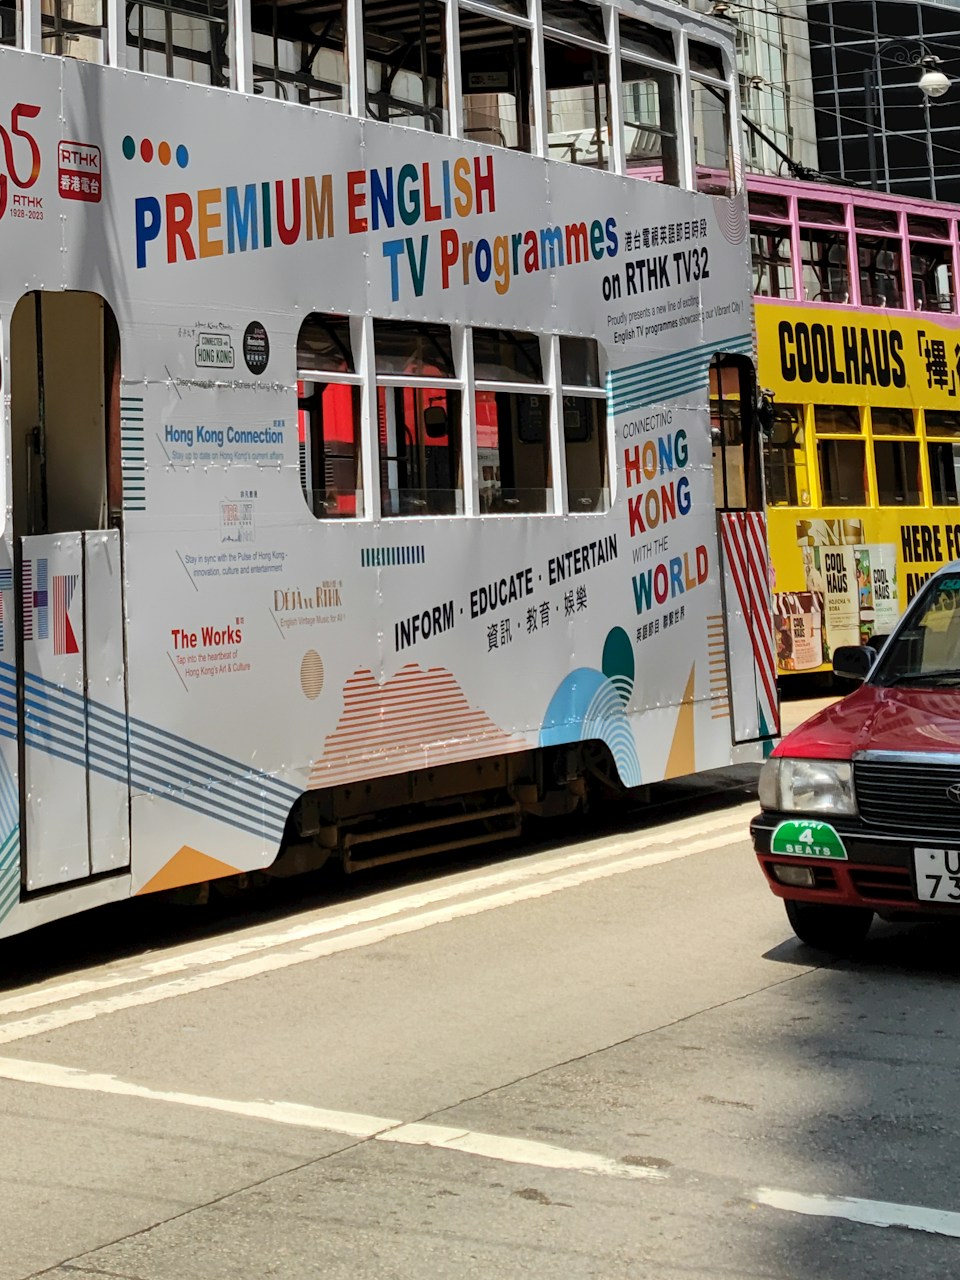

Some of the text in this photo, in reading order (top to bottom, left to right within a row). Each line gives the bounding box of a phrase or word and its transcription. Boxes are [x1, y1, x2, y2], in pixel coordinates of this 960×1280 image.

[61, 149, 99, 168] RTHK
[60, 174, 100, 195] 香港電台
[13, 194, 43, 208] RTHK
[134, 155, 496, 269] PREMIUM ENGLISH
[9, 208, 44, 221] 1928-2023
[624, 218, 707, 252] 港台電視英語節目時段
[382, 217, 619, 302] TV Programmes
[602, 246, 710, 301] on RTHK TV32
[607, 313, 628, 328] Proudly
[628, 308, 650, 324] presents
[656, 304, 667, 315] new
[667, 301, 676, 312] line
[676, 298, 683, 309] of
[683, 295, 700, 308] exciting
[613, 329, 636, 345] English
[636, 325, 645, 337] TV
[645, 320, 678, 338] programmes
[705, 308, 714, 319] our
[714, 303, 731, 317] Vibrant
[731, 301, 742, 315] City
[198, 348, 232, 363] HONG KONG
[778, 320, 907, 389] COOLHAUS
[165, 424, 283, 448] Hong Kong Connection
[623, 410, 673, 440] CONNECTING
[219, 451, 233, 462] Hong
[623, 428, 689, 488] HONG
[628, 476, 691, 538] KONG
[632, 535, 669, 564] WITH THE
[901, 525, 943, 563] HERE
[185, 554, 197, 565] Stay
[204, 555, 216, 565] sync
[217, 553, 227, 563] with
[228, 553, 236, 562] the
[237, 552, 251, 561] Pulse
[253, 552, 258, 560] of
[258, 551, 271, 562] Hong
[272, 550, 285, 561] Kong
[825, 553, 846, 574] COOL
[240, 565, 250, 574] and
[632, 544, 709, 615] WORLD
[873, 569, 889, 585] COOL
[394, 534, 618, 652] INFORM EDUCATE ENTERTAIN
[827, 574, 848, 593] HAUS
[874, 585, 890, 599] HAUS
[171, 625, 242, 650] The Works
[176, 650, 238, 665] Tap into the heartbeat of
[185, 662, 251, 678] Hong Kong's Art & Culture
[798, 829, 814, 845] 4
[786, 844, 831, 856] SEATS
